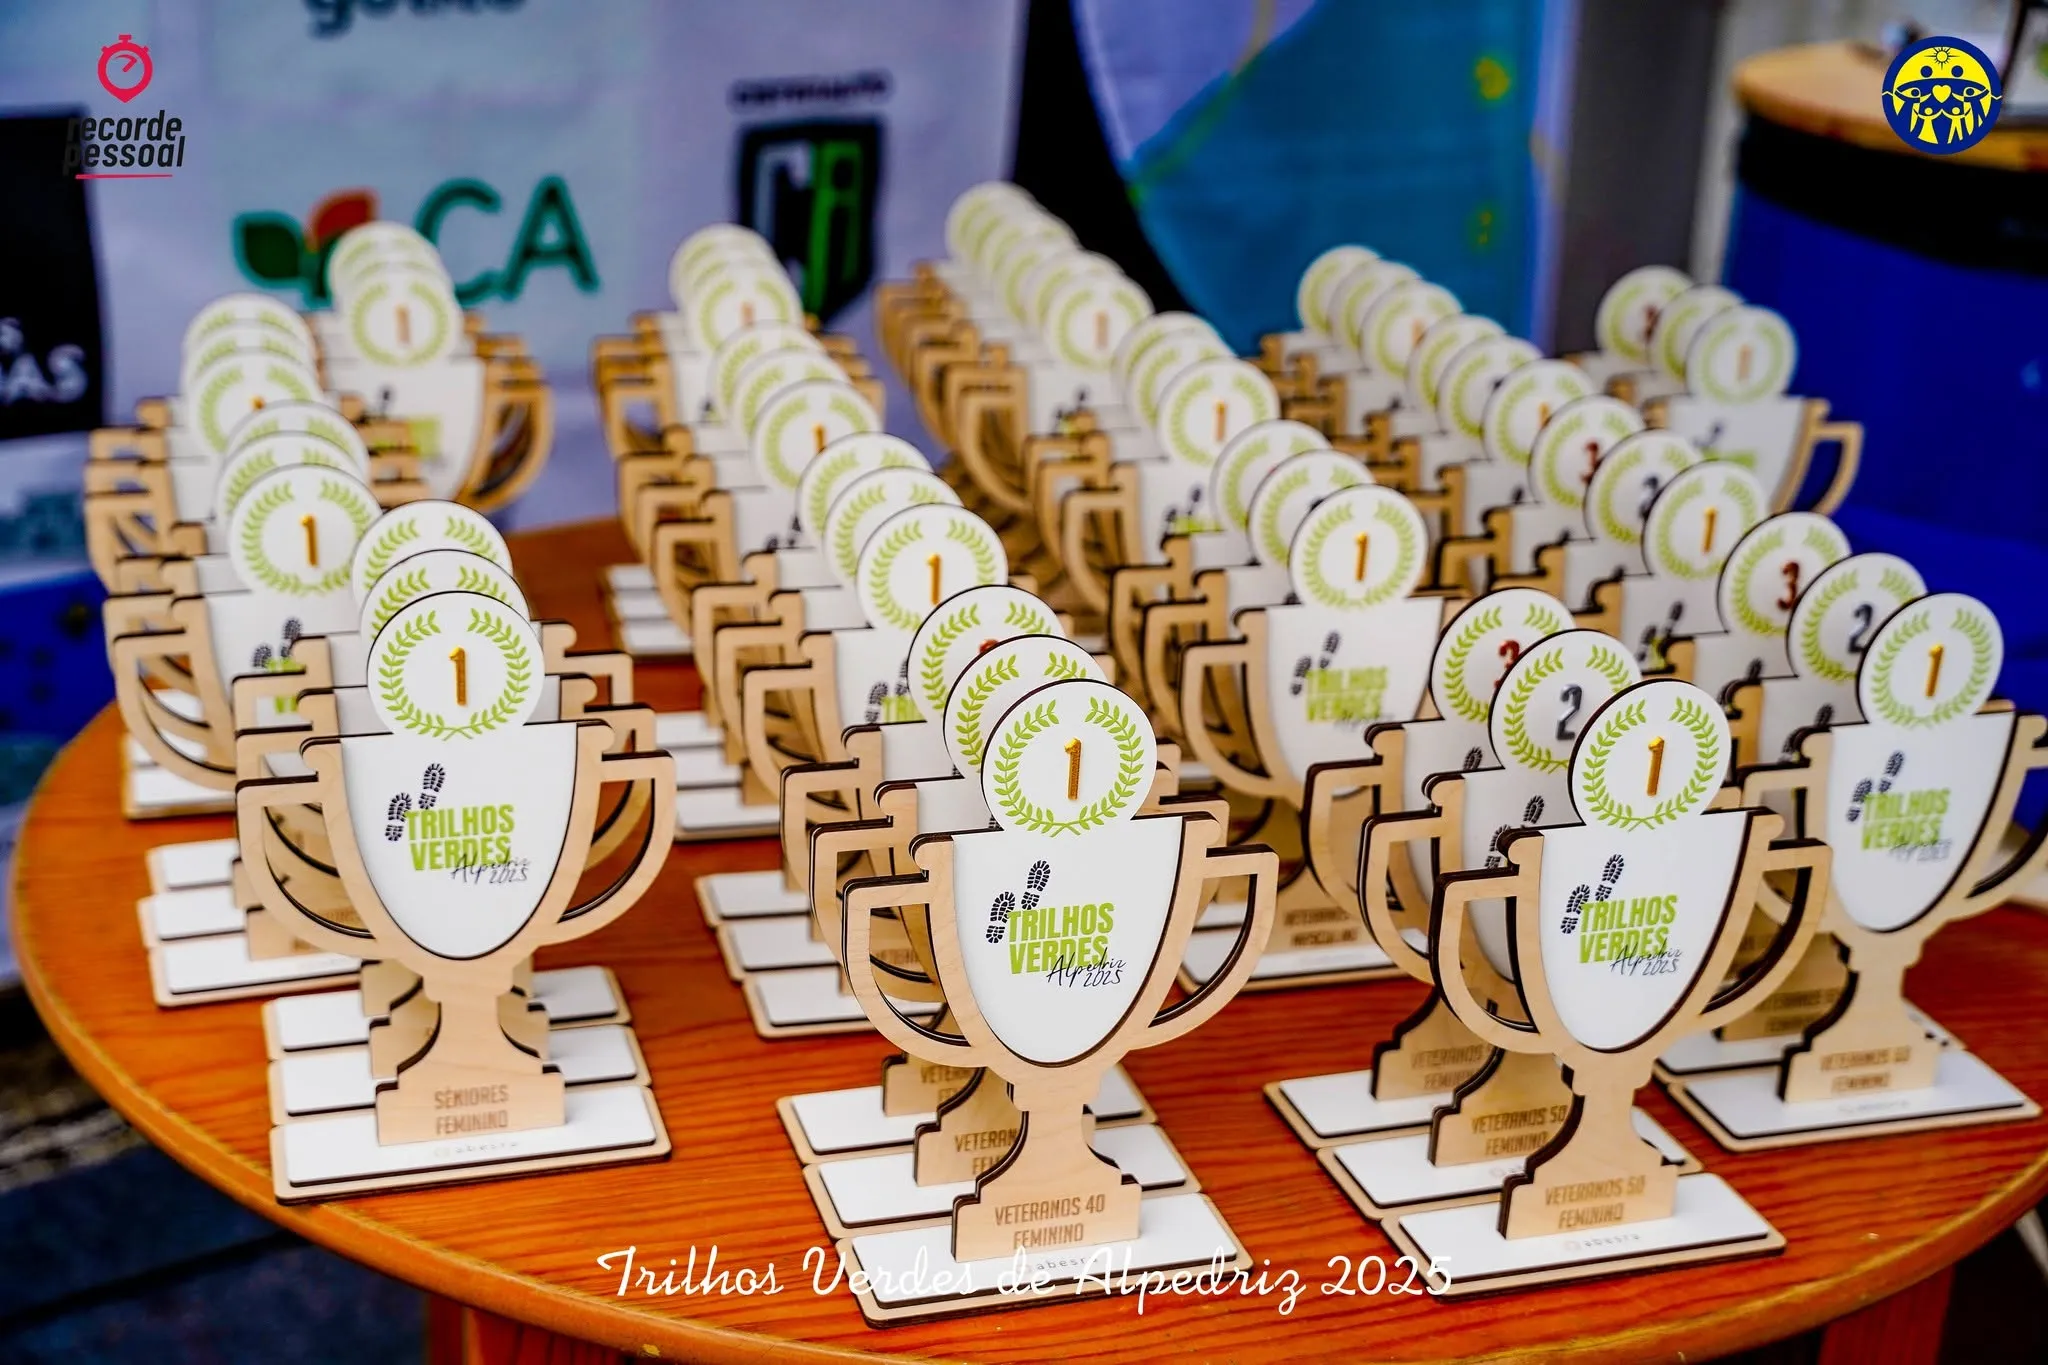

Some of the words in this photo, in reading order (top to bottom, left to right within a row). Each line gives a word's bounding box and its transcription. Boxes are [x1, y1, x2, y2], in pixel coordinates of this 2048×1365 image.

[413, 173, 601, 308] CA
[0, 342, 88, 402] AS
[300, 514, 318, 567] 1
[1704, 507, 1717, 553] 1
[927, 553, 942, 606] 1
[1354, 531, 1369, 583] 1
[1776, 561, 1800, 612] 3
[1847, 602, 1874, 654] 2
[448, 646, 468, 707] 1
[1927, 642, 1945, 698] 1
[1555, 683, 1583, 741] 2
[1063, 737, 1083, 801] 1
[1647, 735, 1665, 798] 1
[404, 804, 515, 840] TRILHOS
[410, 836, 511, 871] VERDES
[1008, 902, 1115, 942] TRILHOS
[1581, 895, 1678, 933] TRILHOS
[1009, 935, 1109, 975] VERDES
[1046, 947, 1127, 988] Alpedriz
[1580, 926, 1669, 963] VERDES
[1642, 959, 1680, 976] 2025
[1083, 969, 1123, 988] 2025
[436, 1109, 508, 1136] FEMININO
[995, 1197, 1081, 1226] VETERANOS
[1086, 1193, 1106, 1214] 40
[1013, 1222, 1084, 1250] FEMININO
